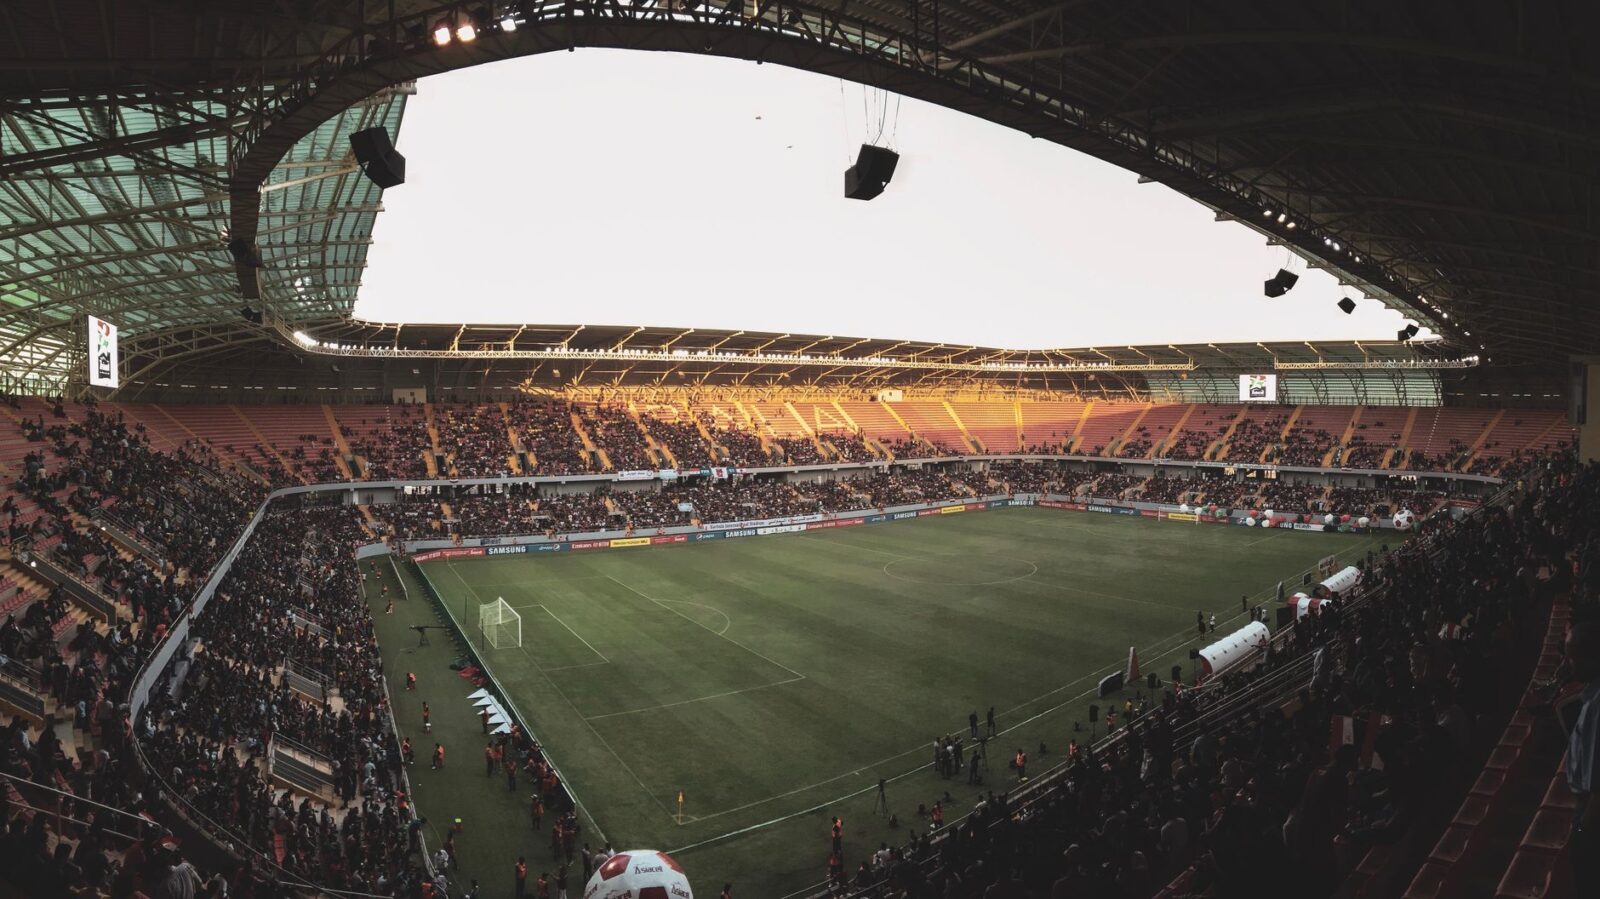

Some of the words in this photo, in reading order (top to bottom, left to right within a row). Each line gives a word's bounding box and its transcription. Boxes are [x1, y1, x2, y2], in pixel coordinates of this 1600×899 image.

[894, 512, 917, 520] SAMSUNG
[726, 529, 756, 538] SAMSUNG
[488, 546, 526, 555] SAMSUNG
[634, 865, 664, 875] Asiacell
